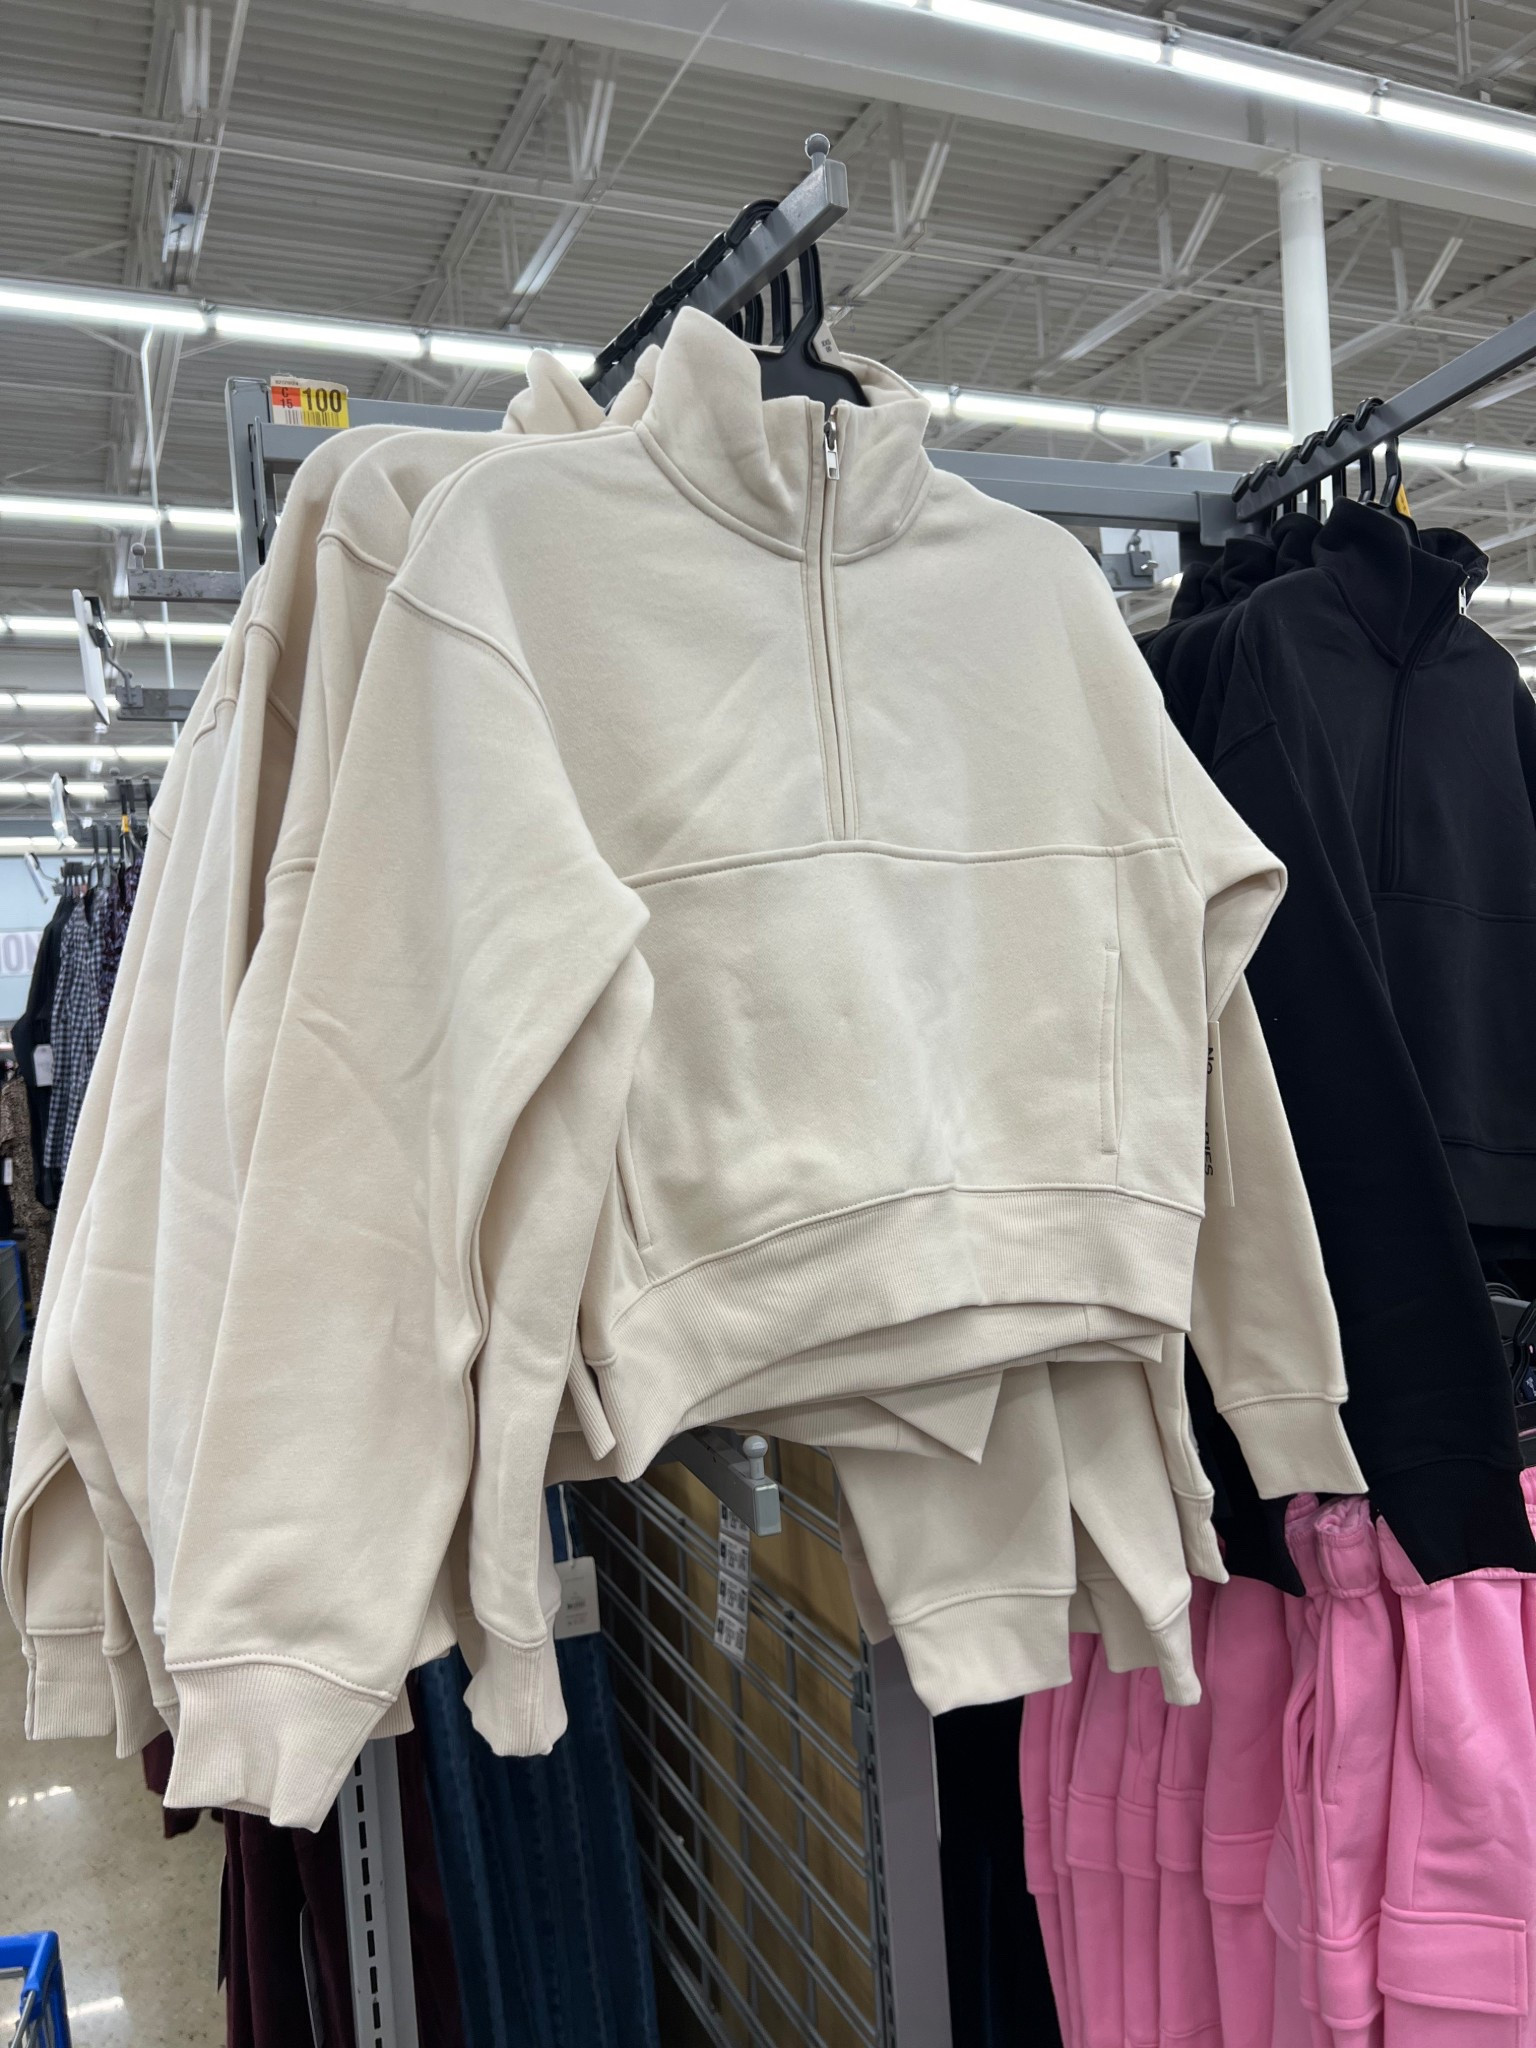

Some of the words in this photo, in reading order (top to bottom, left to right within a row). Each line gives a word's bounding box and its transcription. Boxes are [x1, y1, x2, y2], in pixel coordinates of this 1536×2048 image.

[281, 387, 289, 398] C
[280, 398, 293, 409] 15
[302, 387, 342, 413] 100
